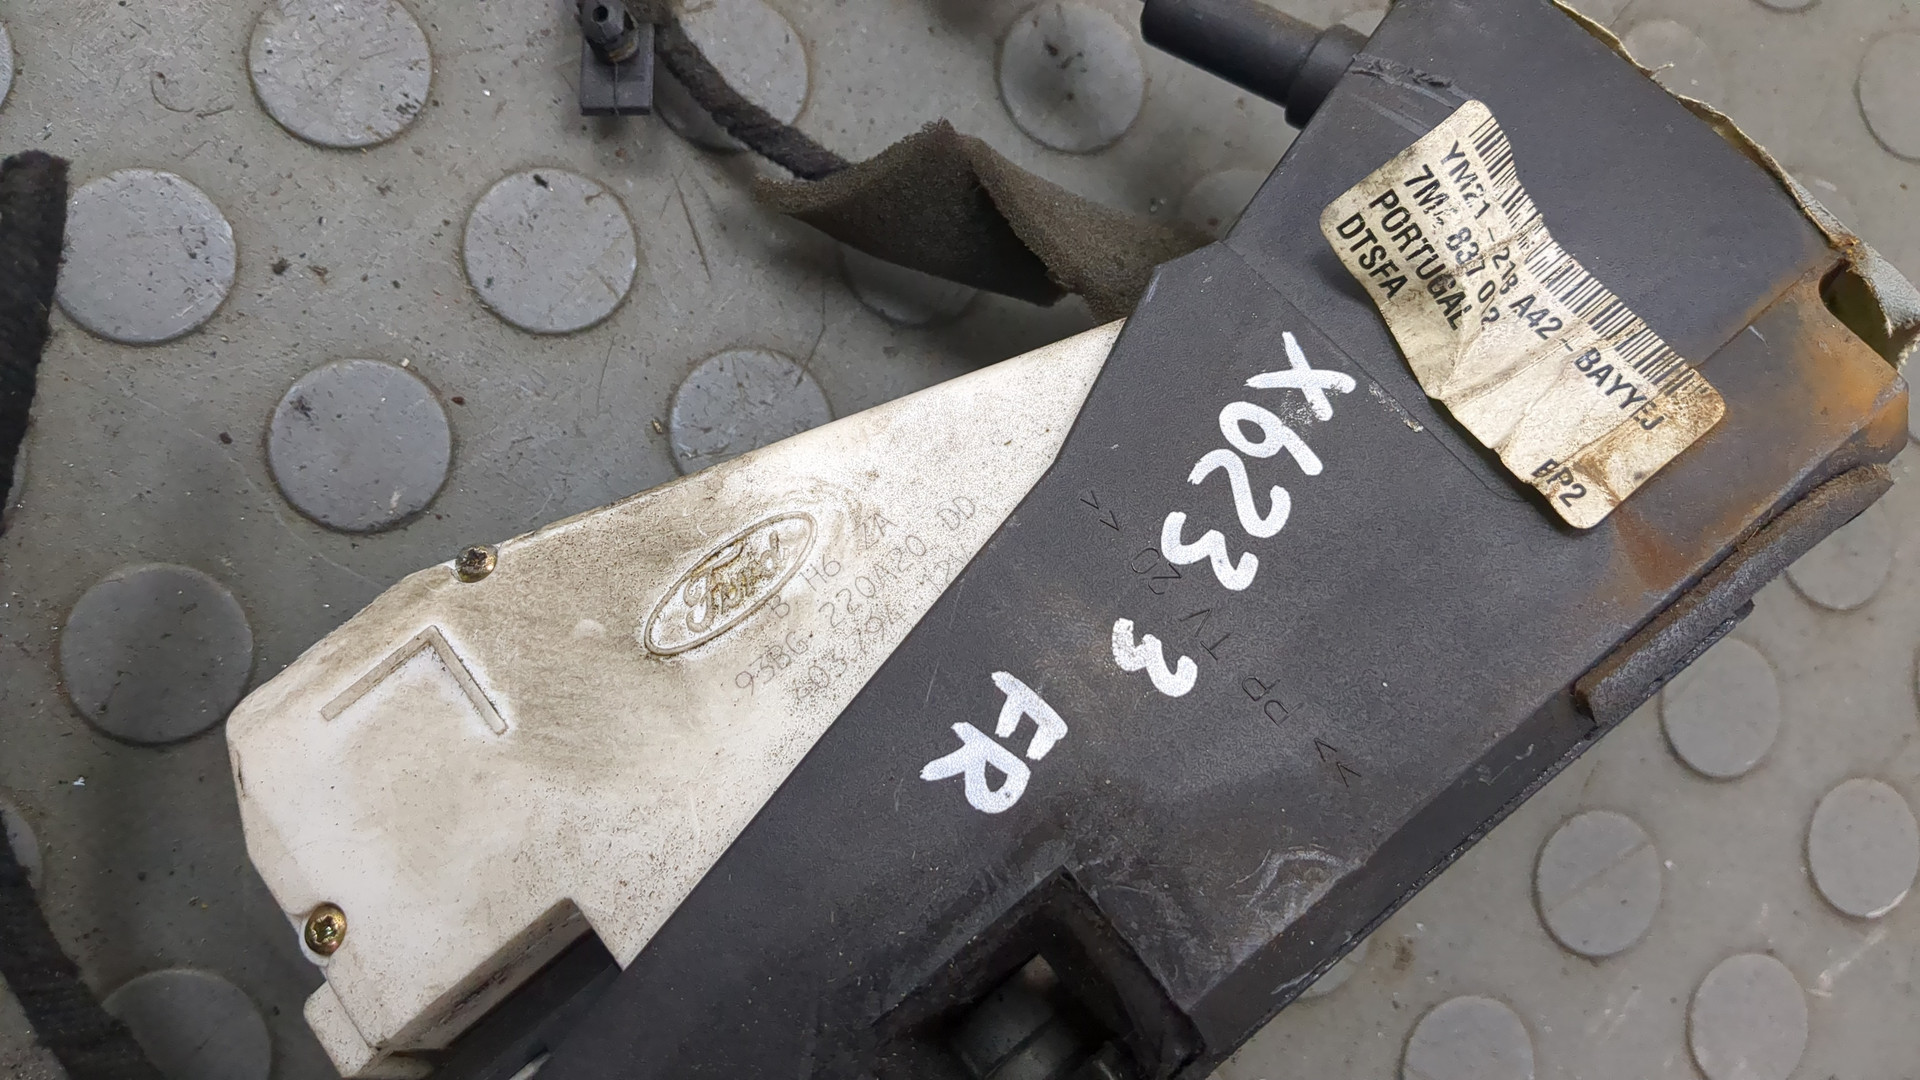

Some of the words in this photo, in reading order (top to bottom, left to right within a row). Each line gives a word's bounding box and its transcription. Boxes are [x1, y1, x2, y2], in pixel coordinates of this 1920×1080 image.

[1335, 212, 1409, 300] DTSFA
[1368, 188, 1473, 331] PORTUGAL
[1440, 140, 1493, 219] YM21
[1509, 294, 1564, 340] A42
[1445, 226, 1486, 277] 837
[1161, 331, 1357, 591] X623
[682, 530, 785, 634] Ford
[818, 535, 927, 628] 220A20
[919, 670, 1069, 814] FR
